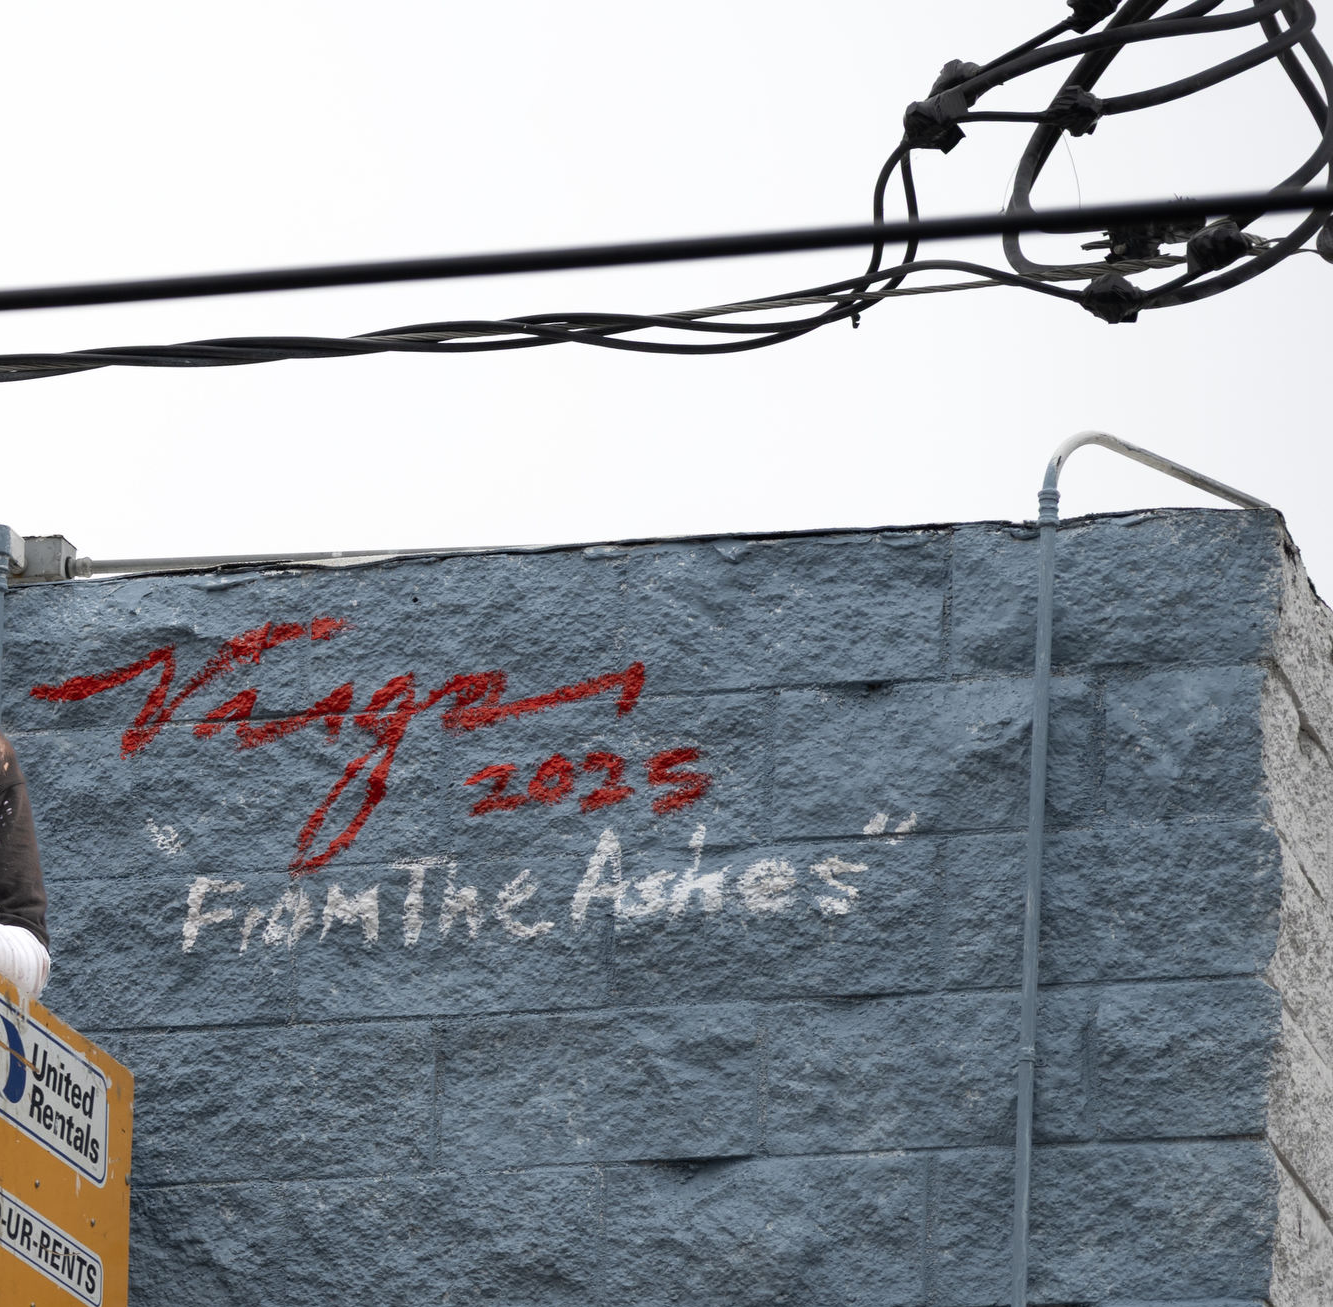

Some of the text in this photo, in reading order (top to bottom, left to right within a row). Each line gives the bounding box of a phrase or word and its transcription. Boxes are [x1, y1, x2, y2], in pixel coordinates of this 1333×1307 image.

[463, 746, 712, 818] 2025
[31, 1042, 96, 1120] United
[28, 1083, 101, 1165] Rentals
